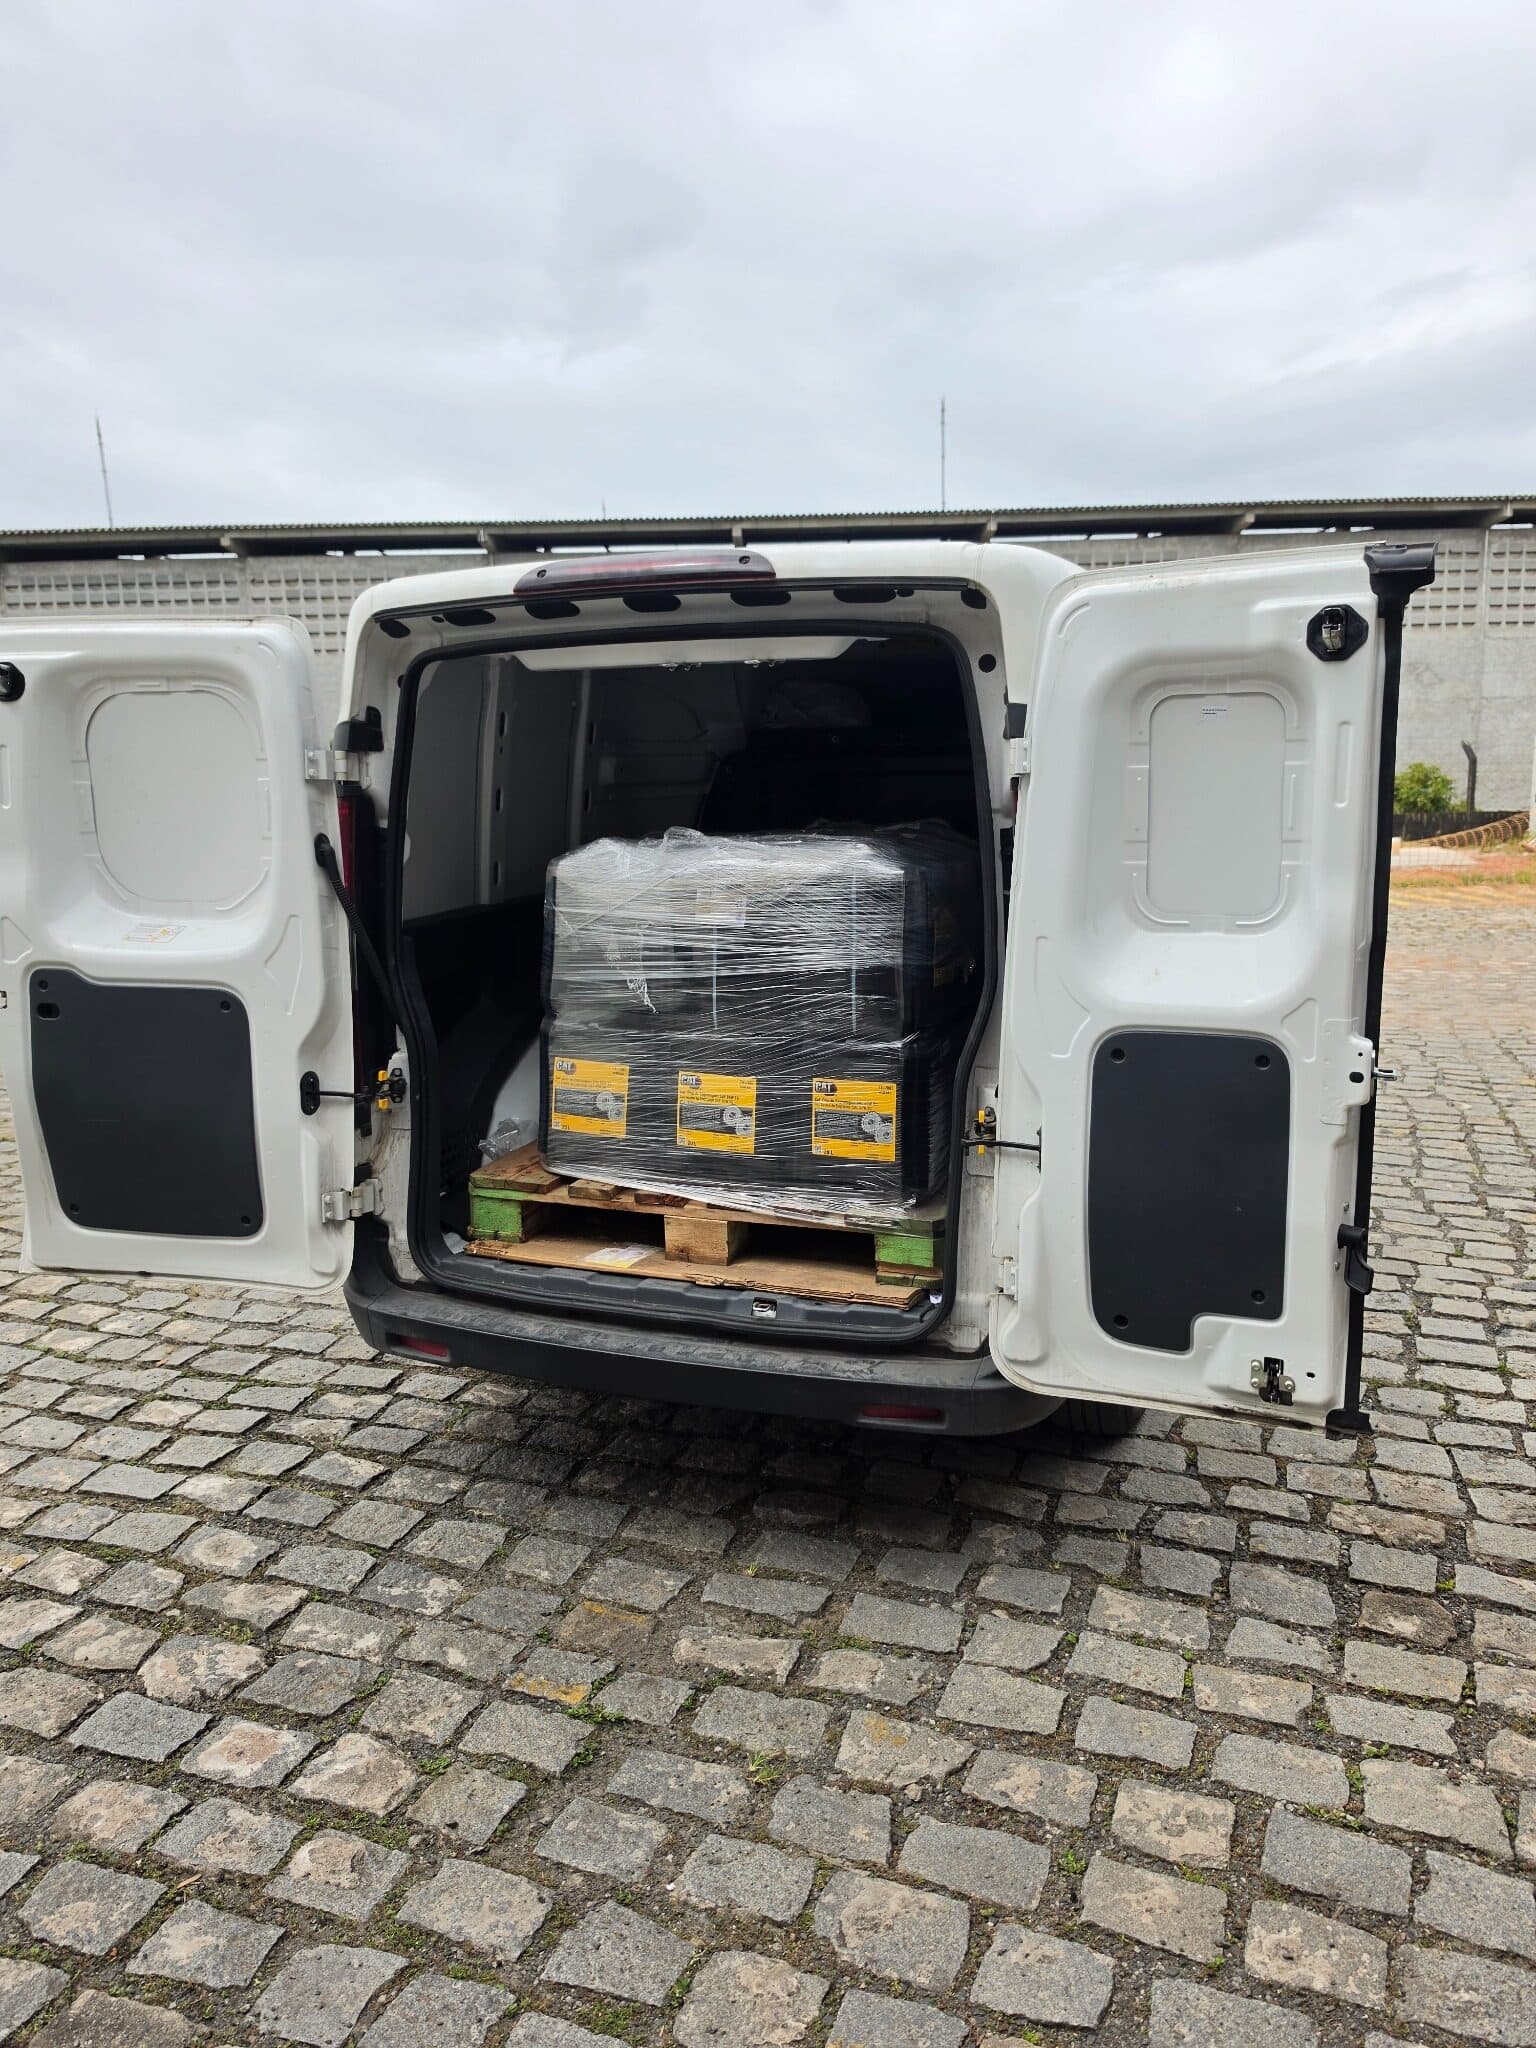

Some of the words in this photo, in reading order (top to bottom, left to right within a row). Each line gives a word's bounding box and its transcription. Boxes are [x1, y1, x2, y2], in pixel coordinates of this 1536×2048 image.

[556, 1061, 573, 1072] CAT
[681, 1075, 698, 1086] CAT
[815, 1082, 832, 1093] CAT
